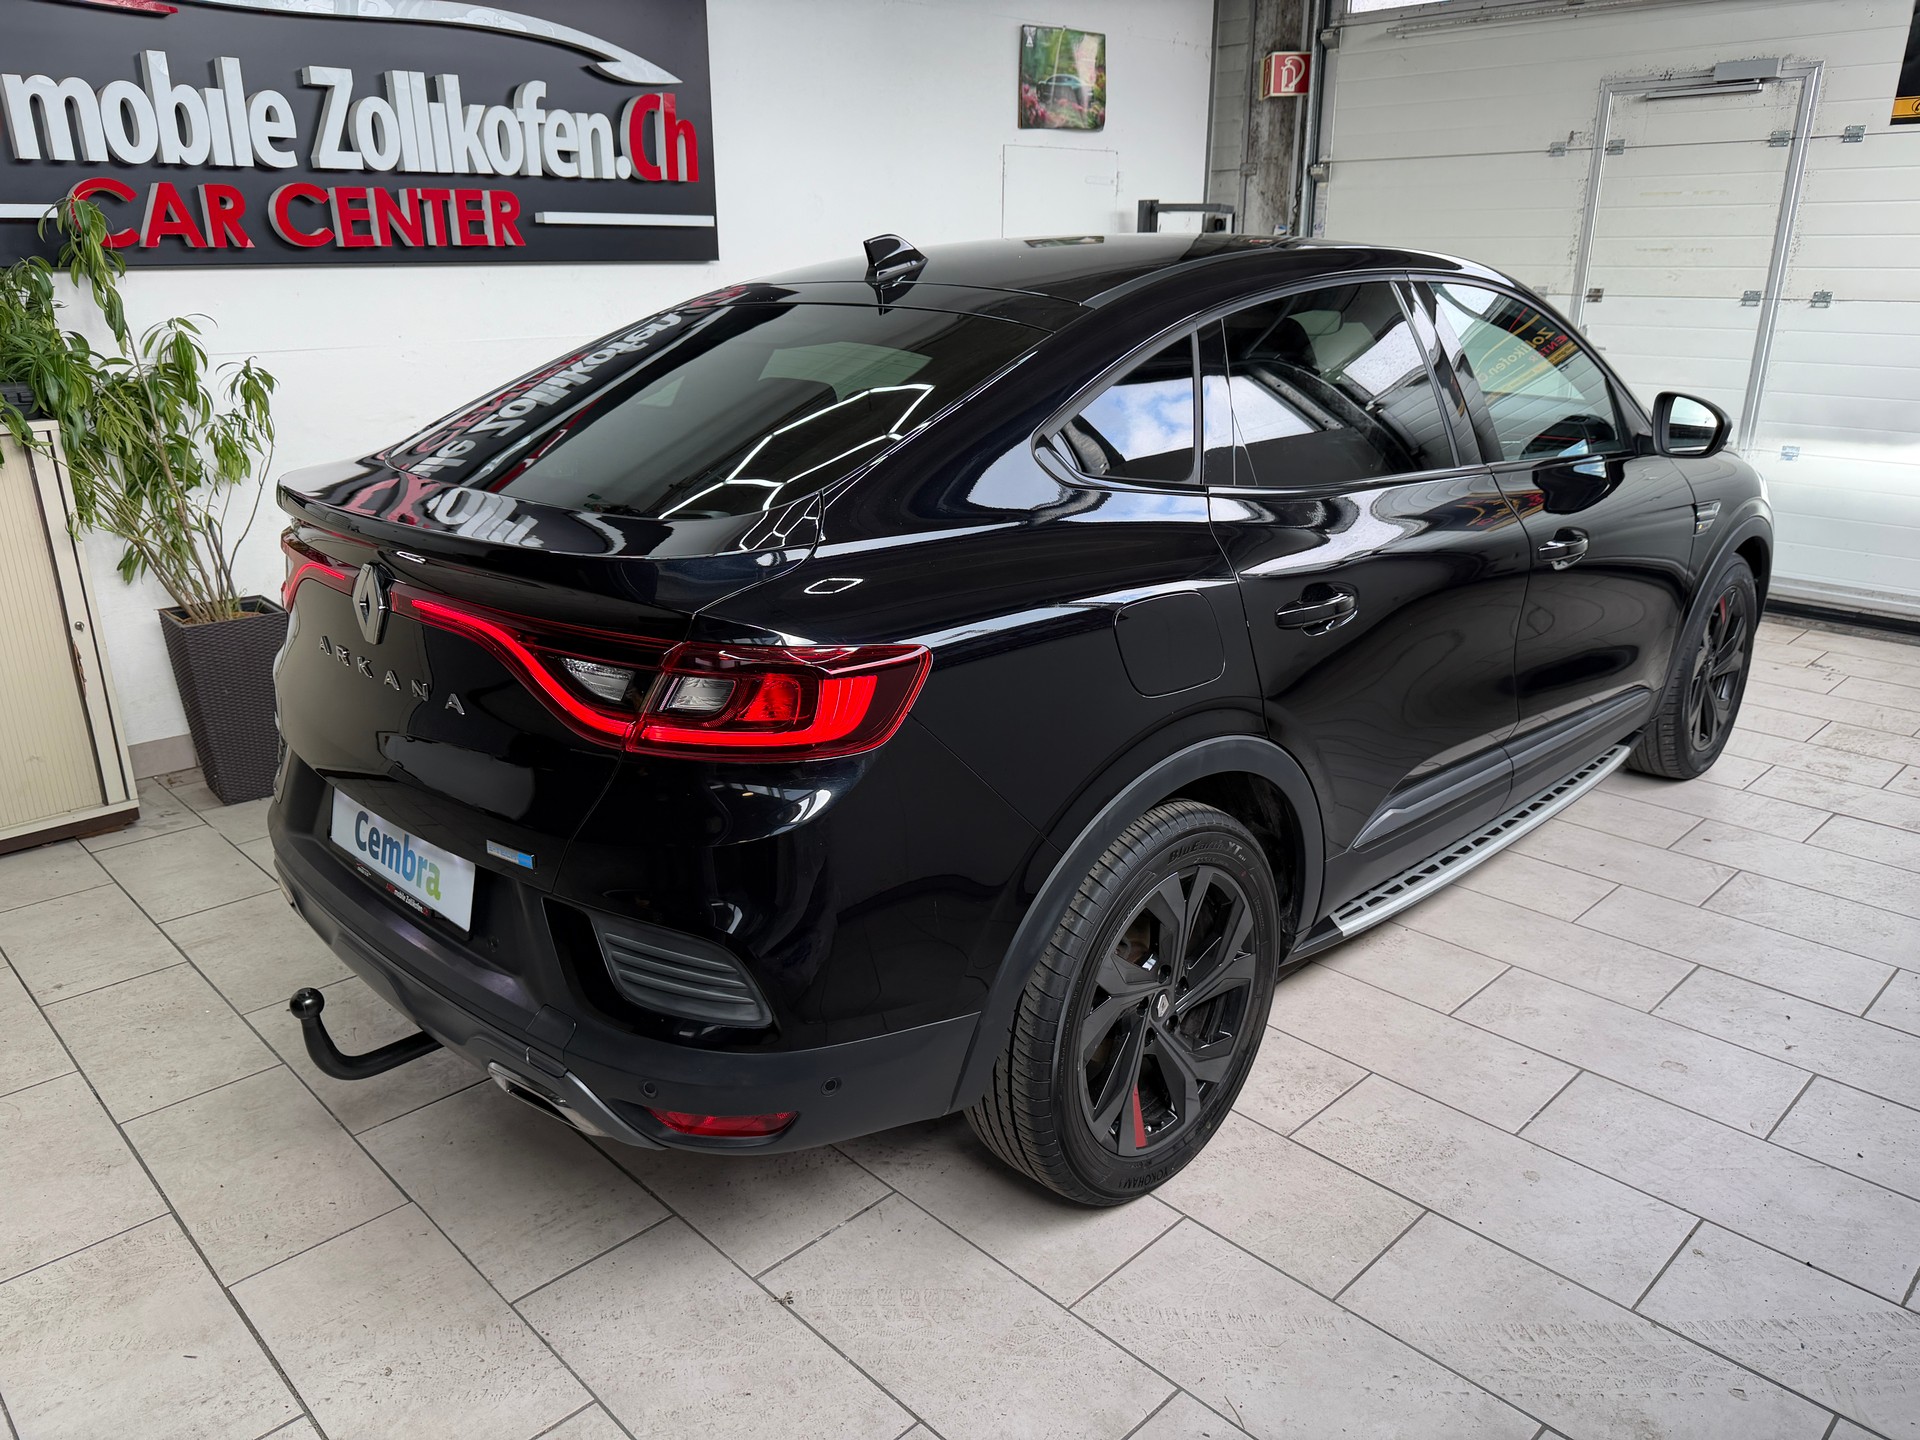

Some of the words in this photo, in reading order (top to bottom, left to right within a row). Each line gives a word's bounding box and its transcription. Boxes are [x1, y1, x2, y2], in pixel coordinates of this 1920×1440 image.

[1, 48, 298, 170] mobile
[301, 65, 699, 182] Zollikofen.Ch
[67, 176, 256, 249] CAR
[267, 182, 527, 248] CENTER
[318, 634, 466, 716] ARKANA
[354, 811, 441, 901] Cembra
